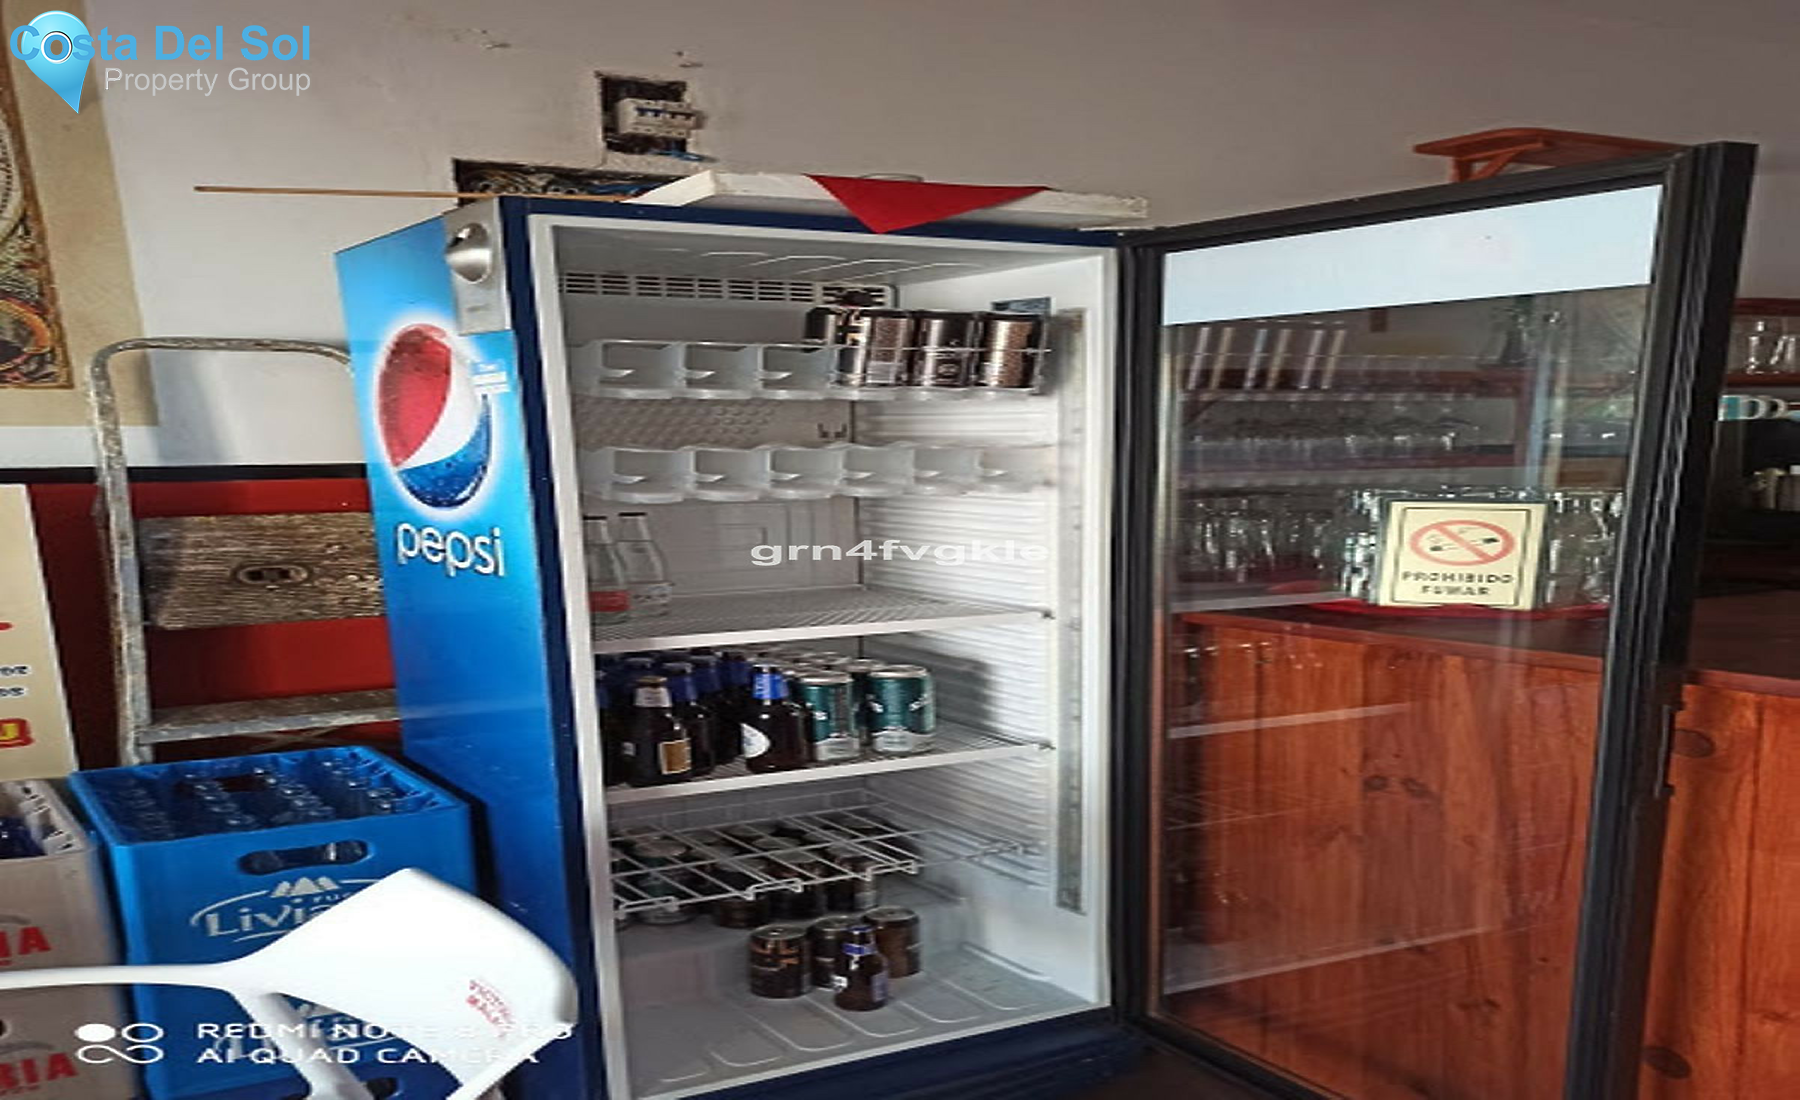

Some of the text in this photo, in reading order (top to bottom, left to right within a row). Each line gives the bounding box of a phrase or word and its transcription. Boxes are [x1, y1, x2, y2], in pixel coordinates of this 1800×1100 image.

[396, 522, 505, 577] pepsi
[1402, 570, 1515, 584] PROHIBIDO
[1421, 585, 1491, 596] FUMAR
